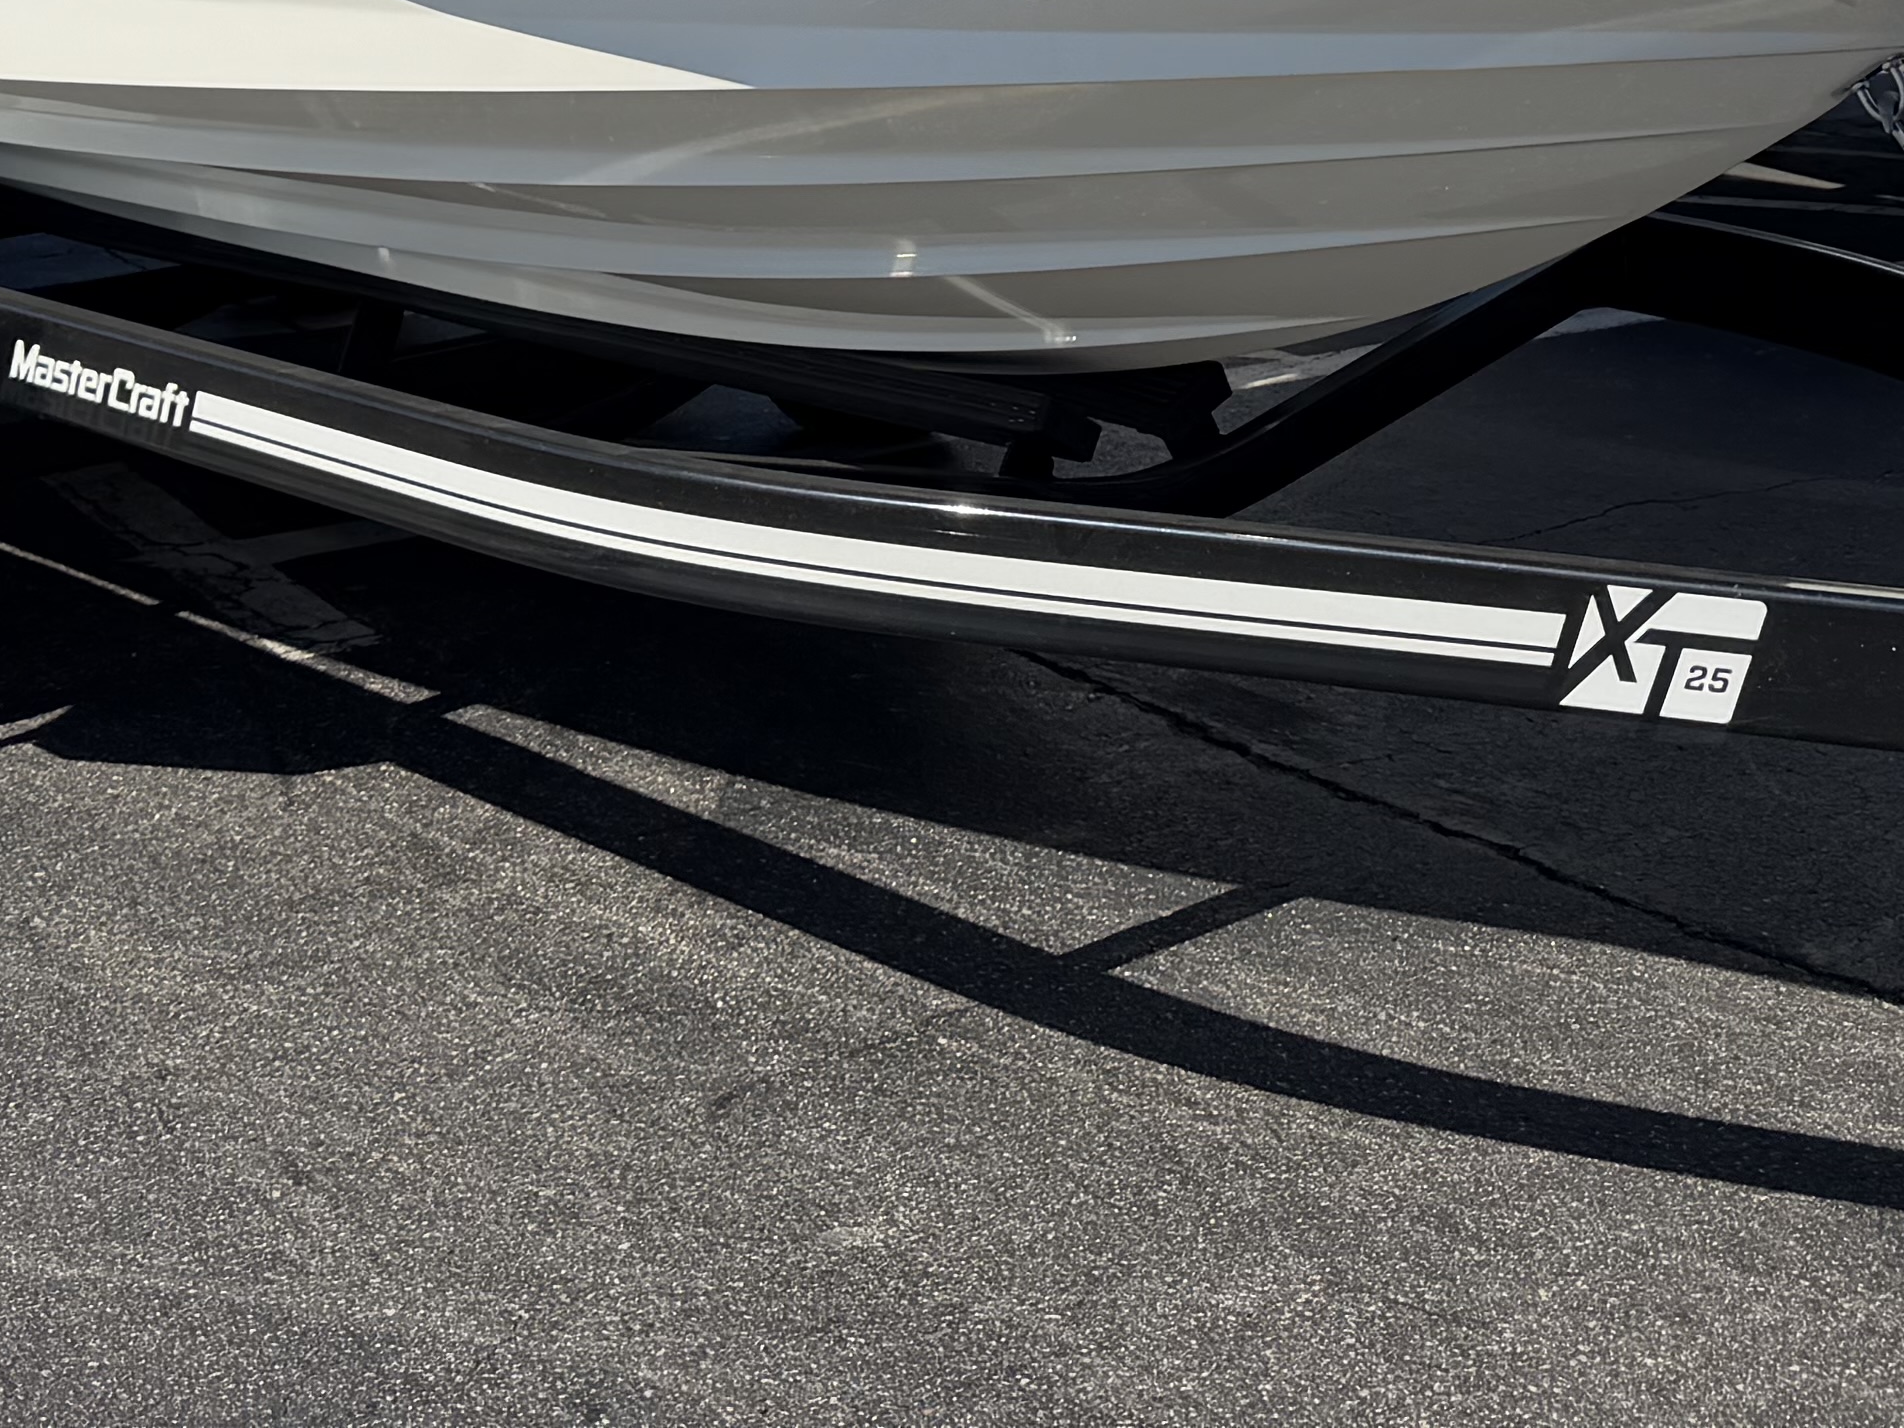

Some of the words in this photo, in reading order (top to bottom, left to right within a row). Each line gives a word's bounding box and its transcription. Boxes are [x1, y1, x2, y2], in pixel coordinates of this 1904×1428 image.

[9, 339, 190, 427] MasterCraft
[1559, 584, 1765, 719] XT
[1684, 665, 1733, 694] 25
